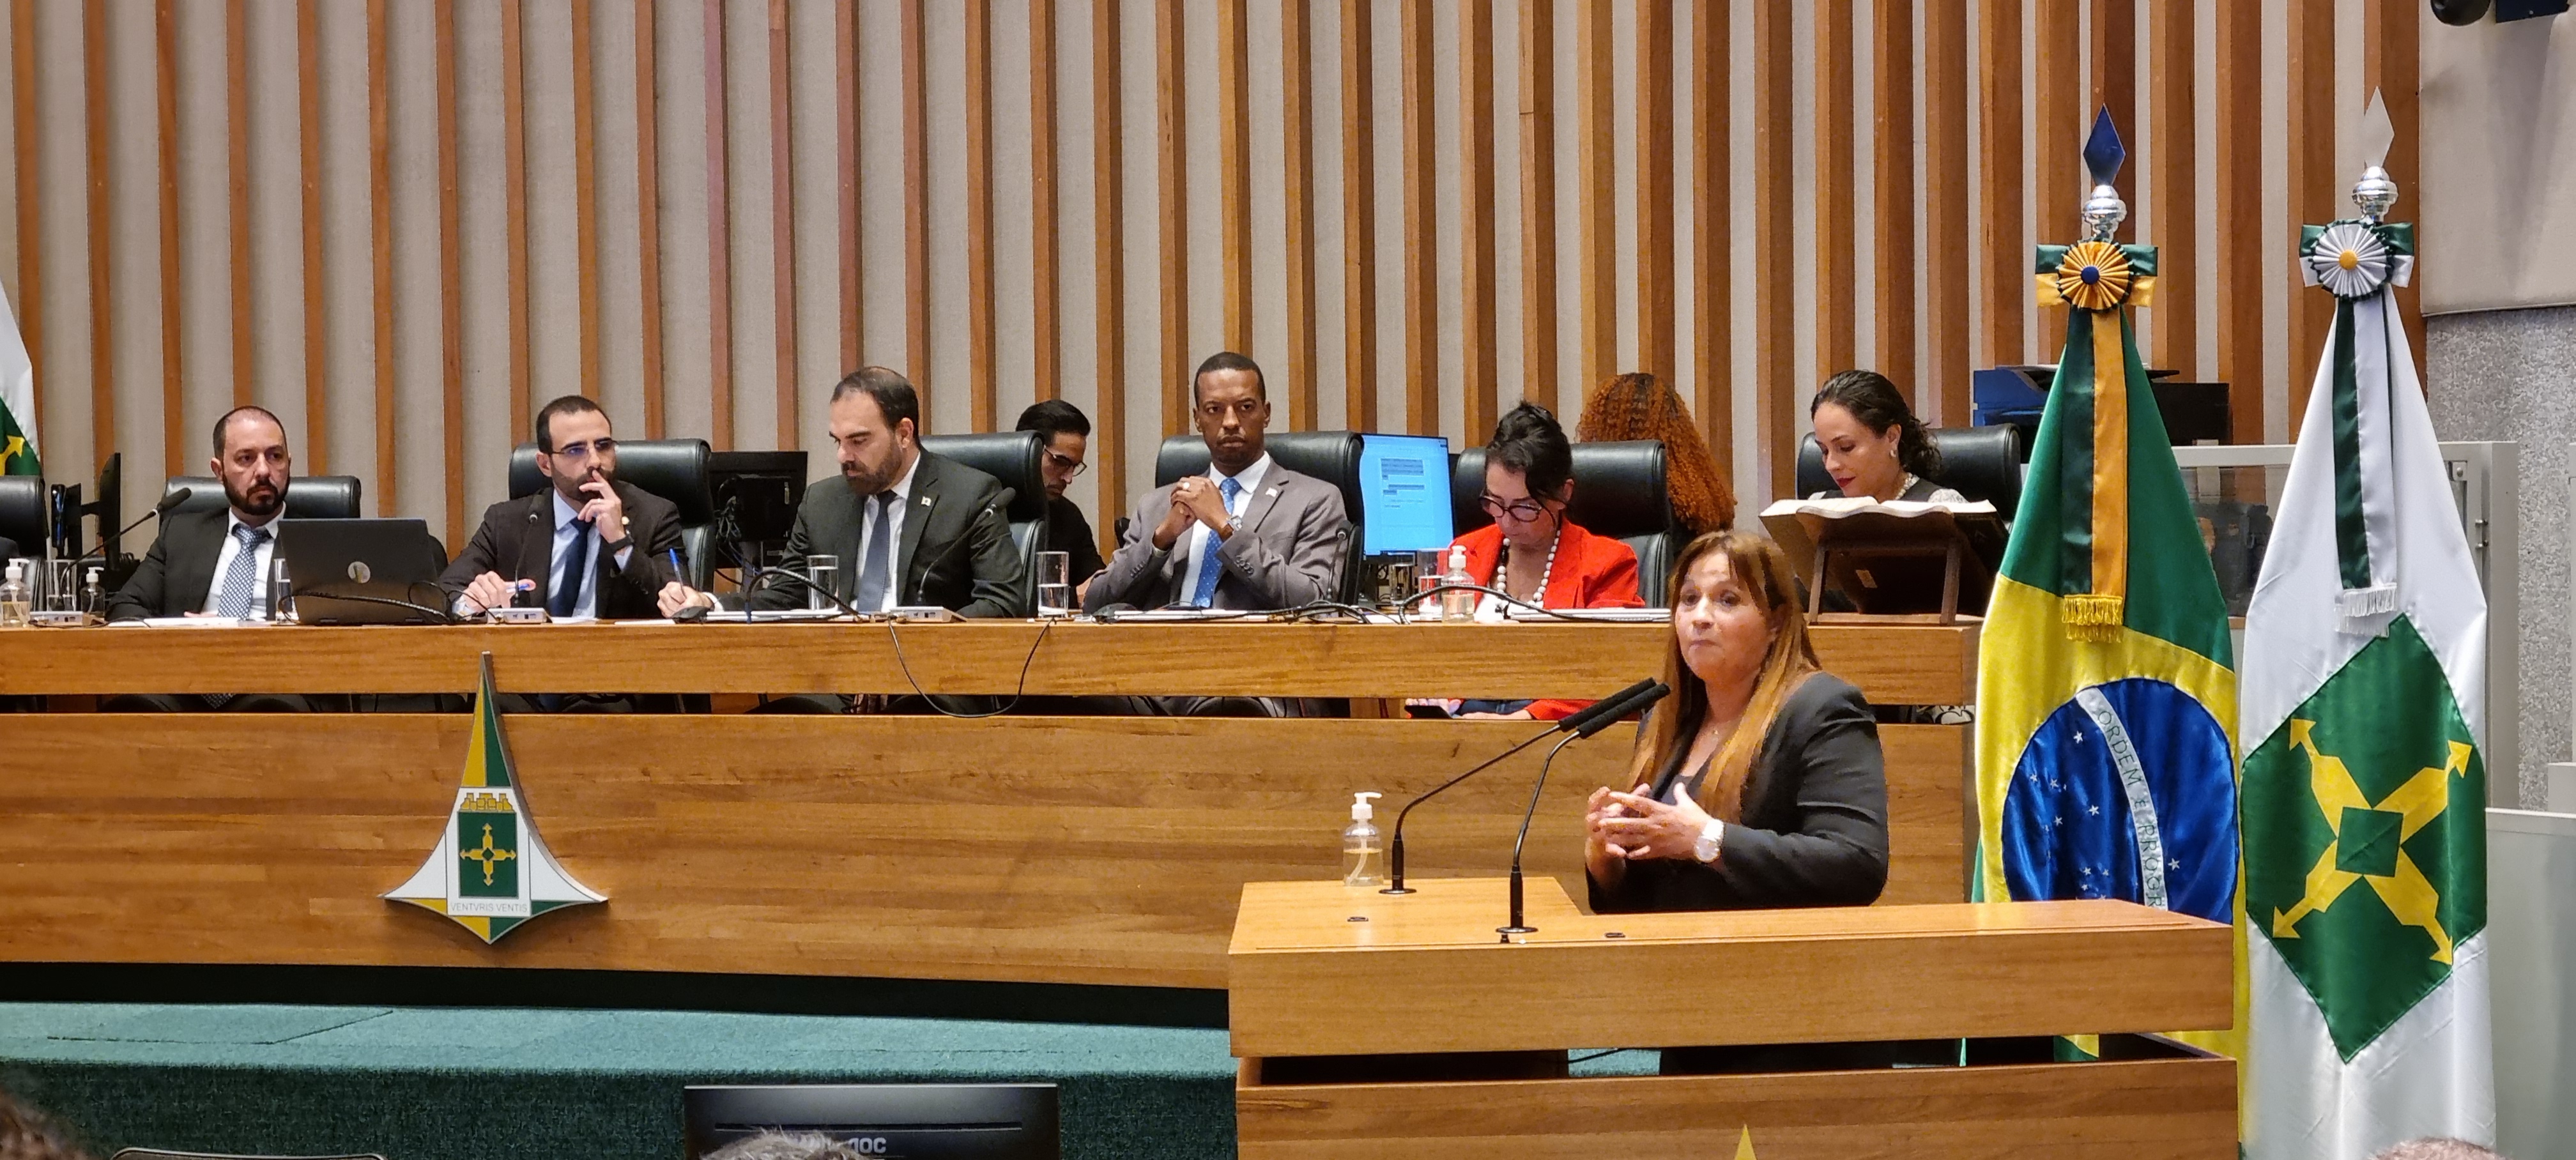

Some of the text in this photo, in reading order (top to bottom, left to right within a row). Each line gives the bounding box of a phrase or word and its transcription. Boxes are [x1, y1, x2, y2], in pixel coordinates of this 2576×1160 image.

[2098, 711, 2142, 786] ORDEM
[450, 903, 528, 913] VENTVRIS VENTIS
